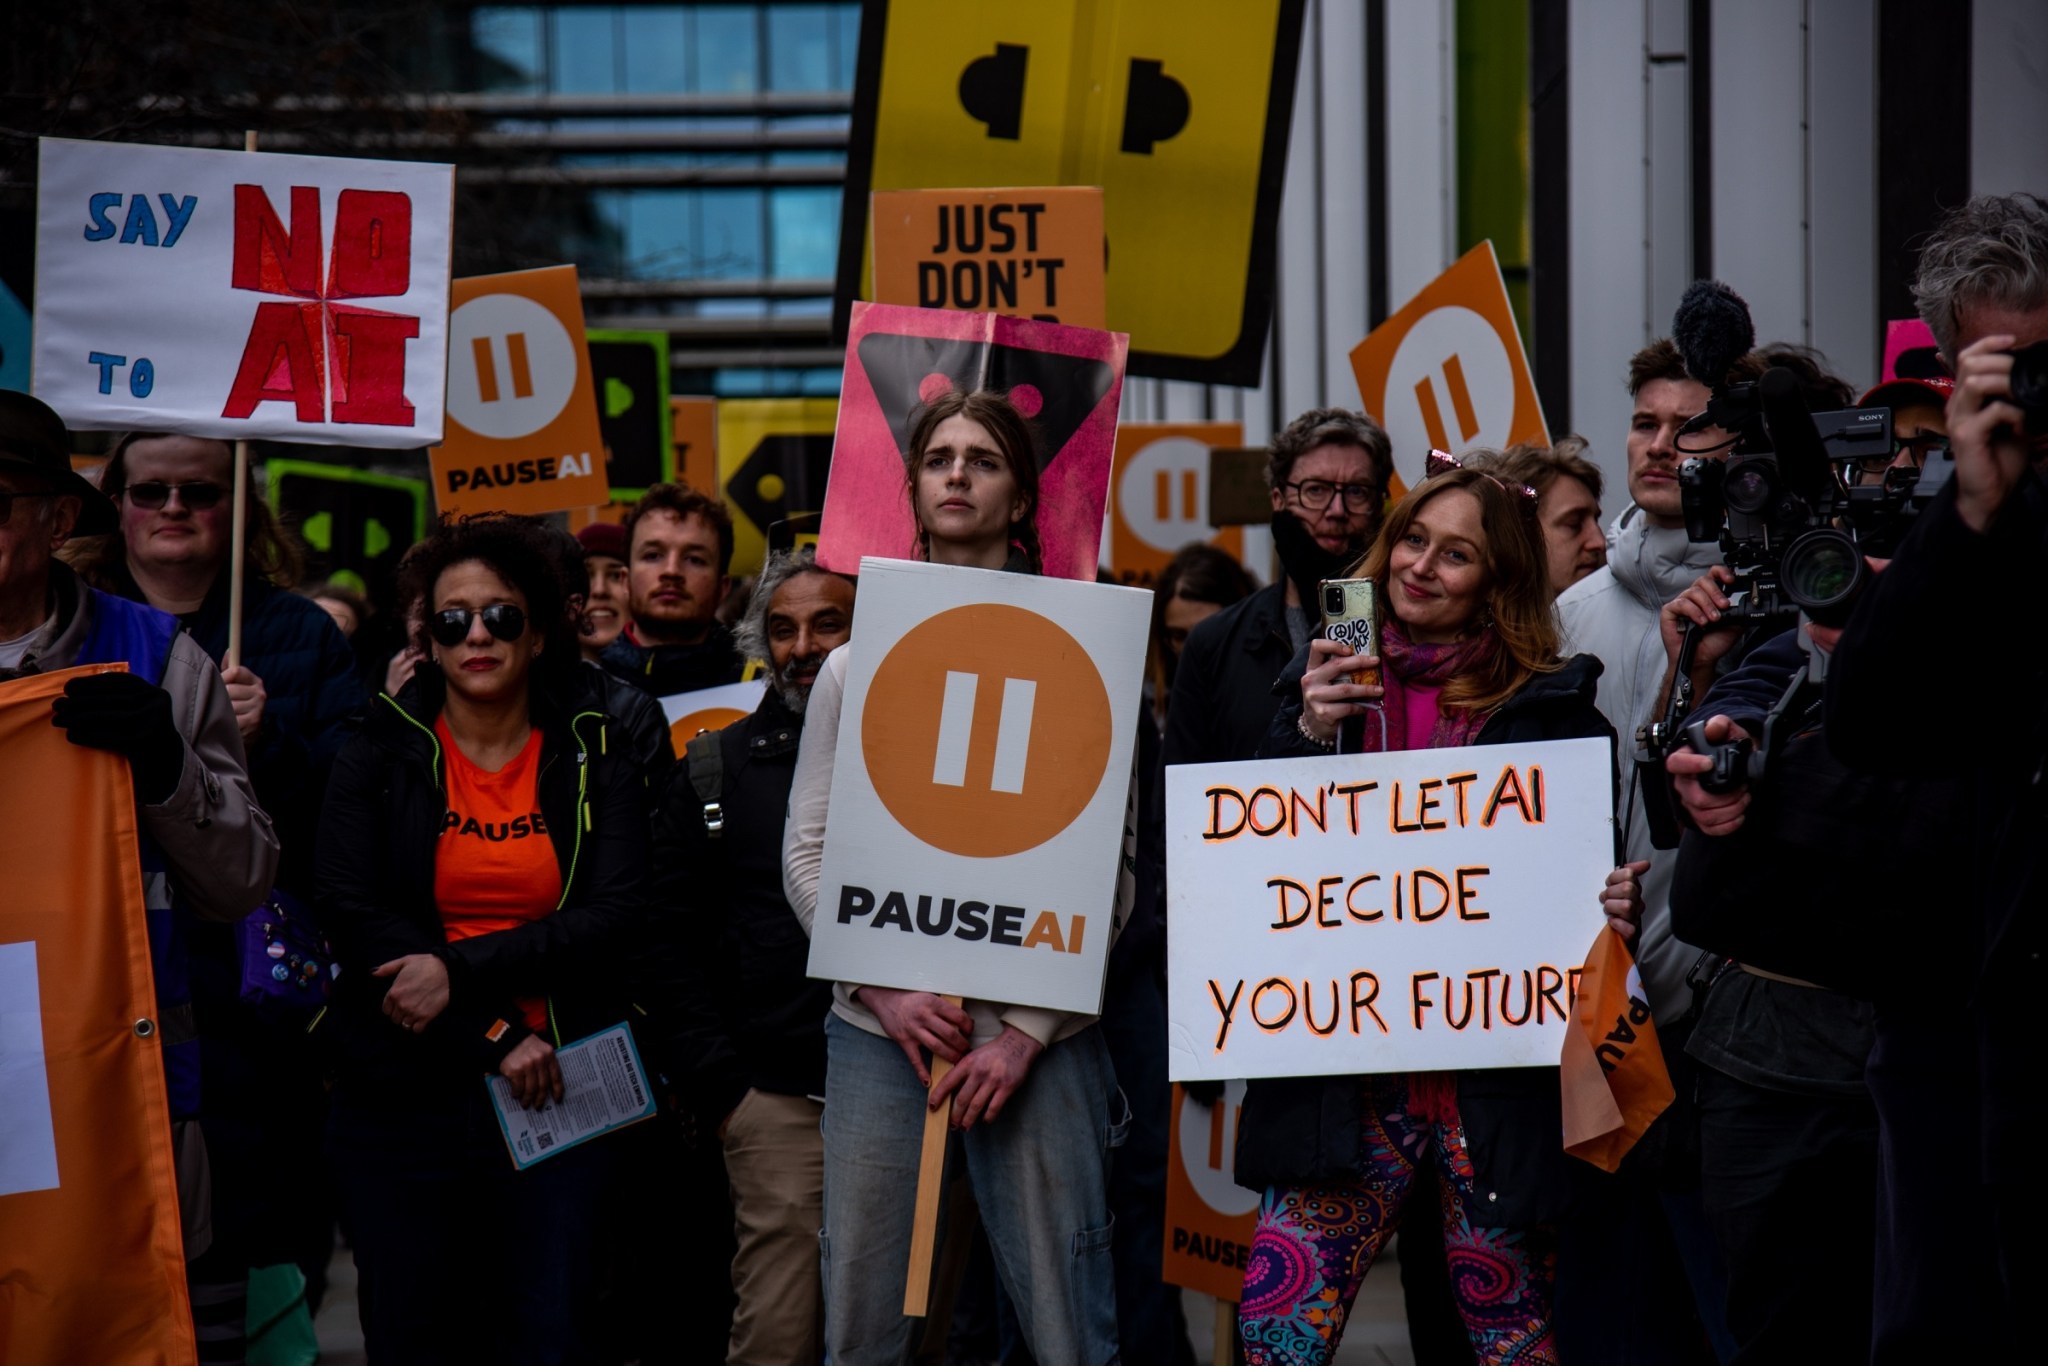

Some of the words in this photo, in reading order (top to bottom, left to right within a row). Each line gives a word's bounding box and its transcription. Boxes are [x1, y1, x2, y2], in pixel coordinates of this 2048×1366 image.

[84, 192, 197, 247] SAY
[232, 184, 412, 298] NO
[933, 204, 1045, 253] JUST
[919, 259, 1064, 308] DON'T
[89, 352, 154, 398] TO
[221, 302, 420, 426] AI
[447, 452, 593, 492] PAUSEAI
[440, 811, 548, 842] PAUSE
[1202, 781, 1378, 841] DON'T
[1391, 773, 1478, 833] LET
[1481, 765, 1545, 827] AI
[837, 885, 1086, 954] PAUSEAI
[1267, 868, 1491, 930] DECIDE
[1208, 971, 1389, 1052] YOUR
[1173, 1226, 1250, 1270] PAUSE
